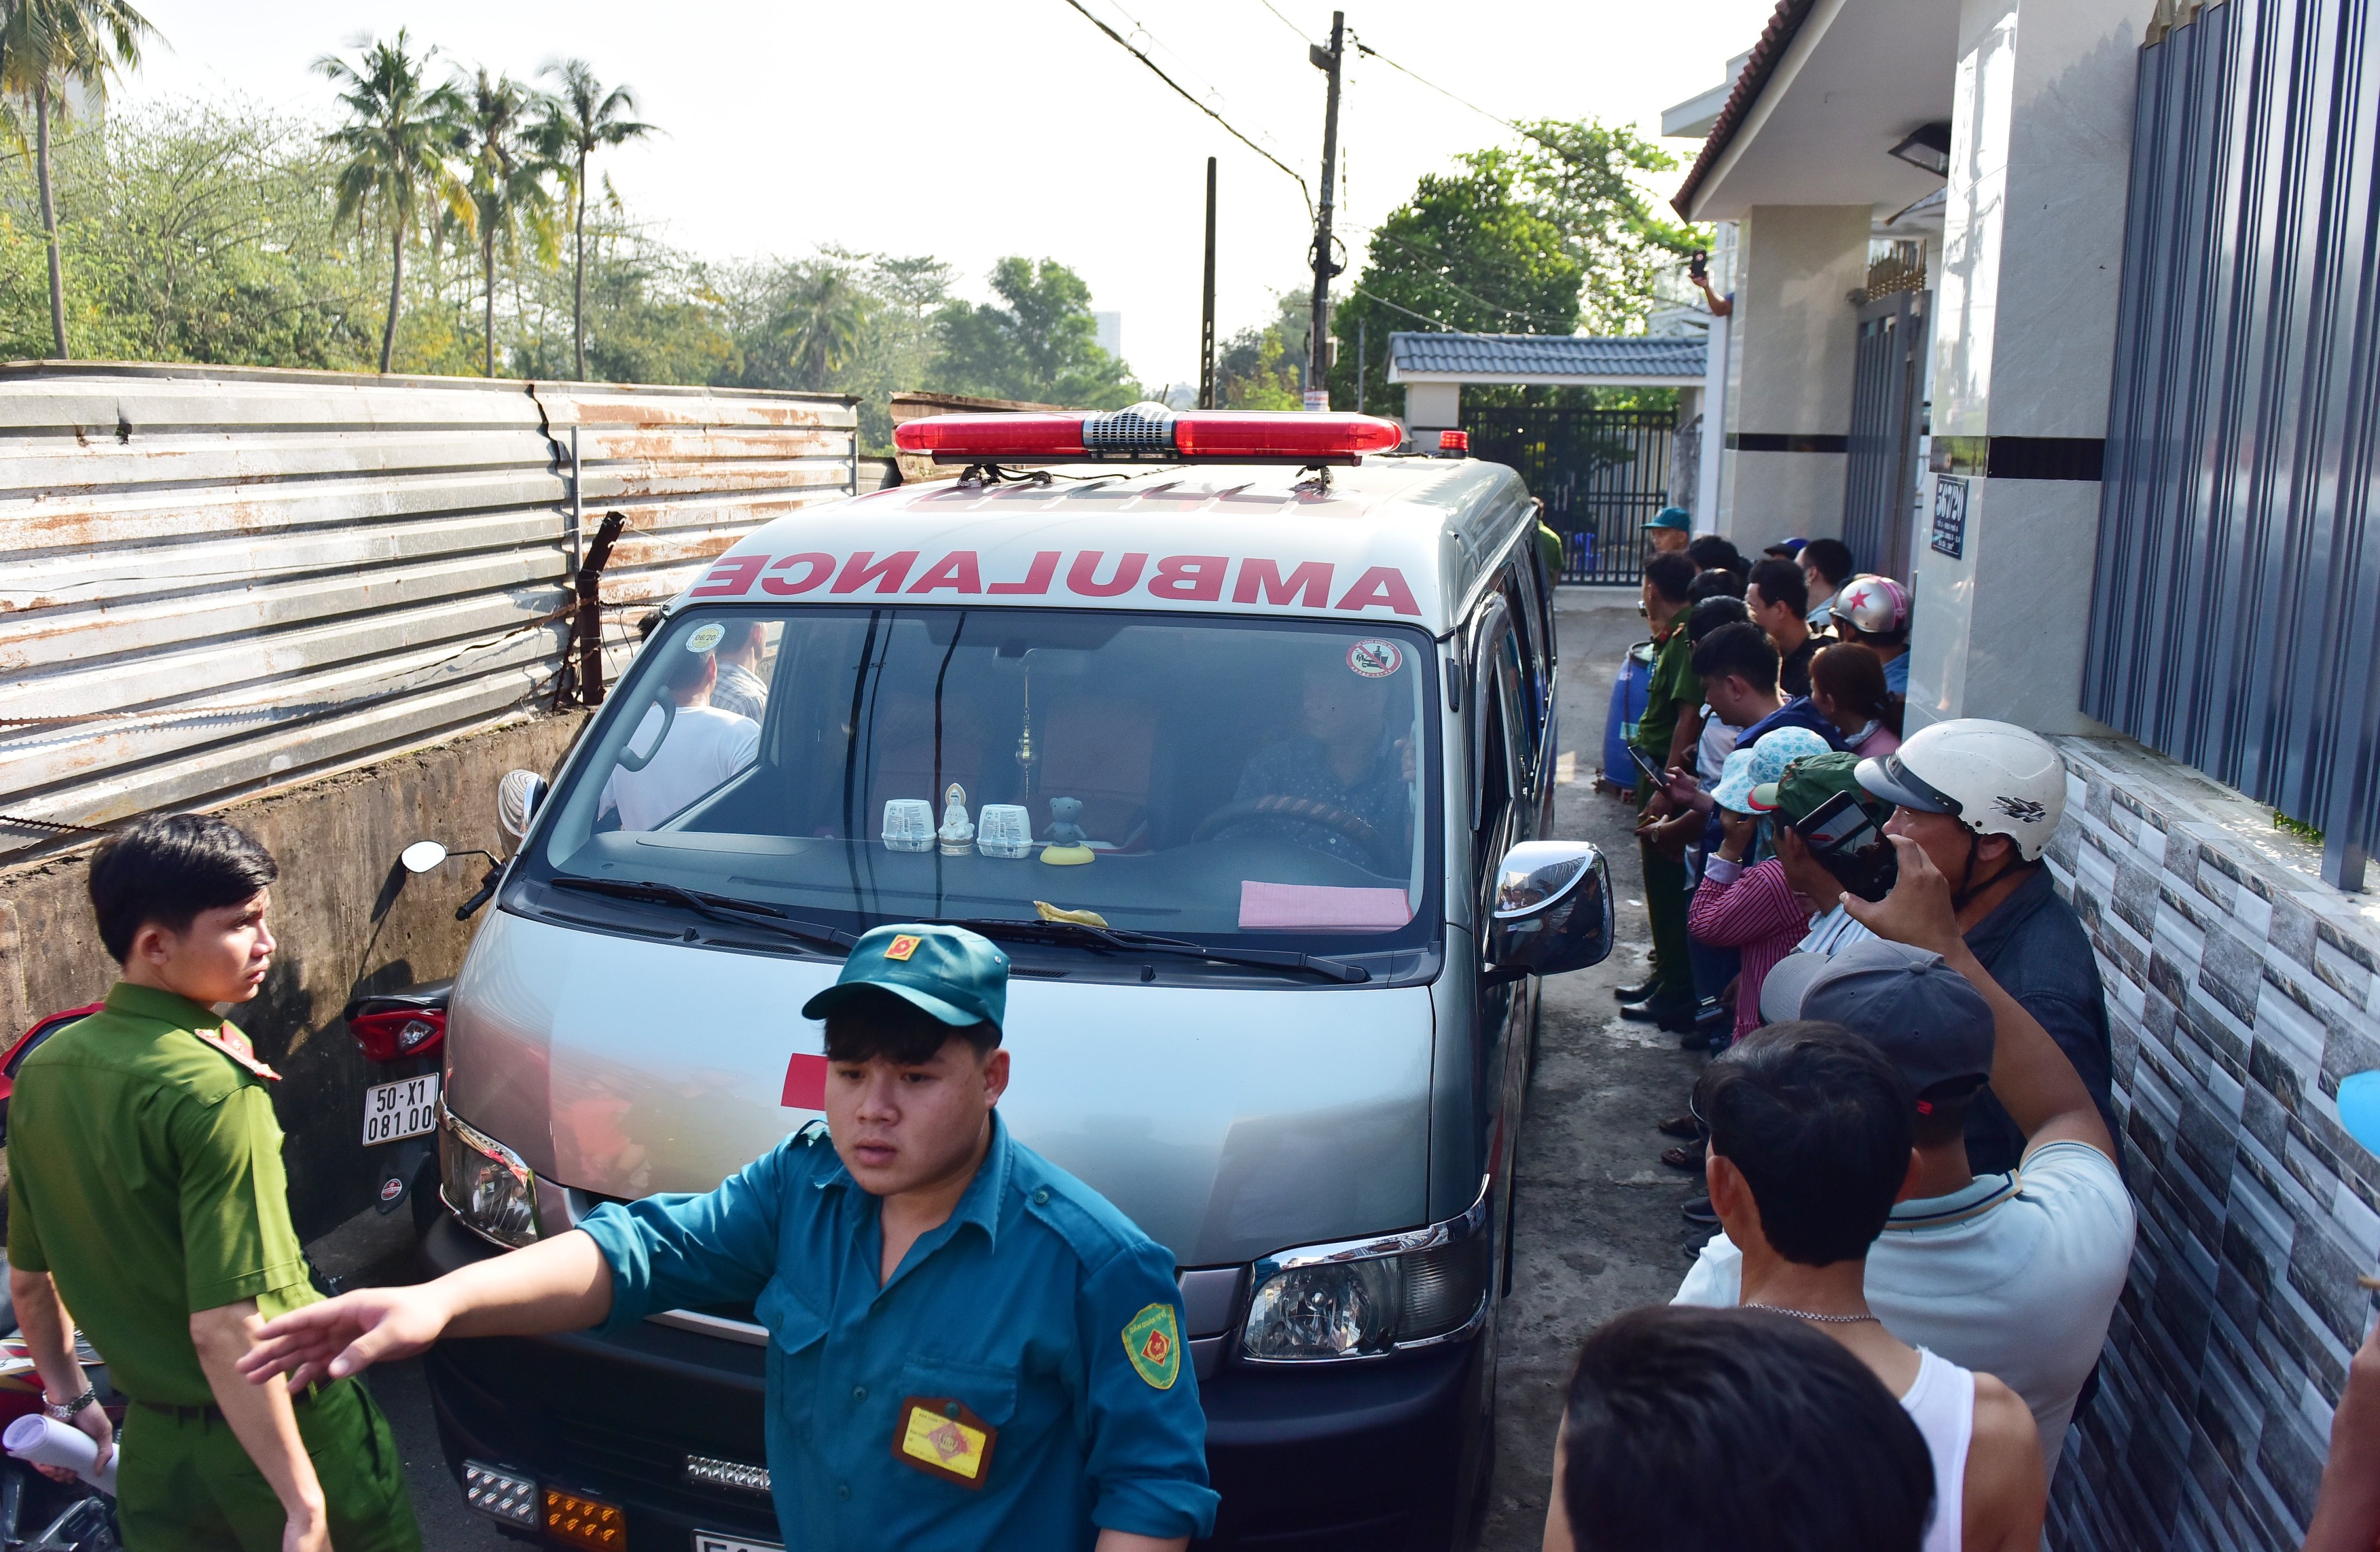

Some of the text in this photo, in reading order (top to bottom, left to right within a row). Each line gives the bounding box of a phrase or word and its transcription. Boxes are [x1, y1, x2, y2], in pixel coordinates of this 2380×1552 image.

[1937, 483, 1963, 521] 567/20
[377, 1079, 425, 1113] 50-X1
[368, 1105, 432, 1141] 081.00
[1129, 1324, 1142, 1334] DÂN
